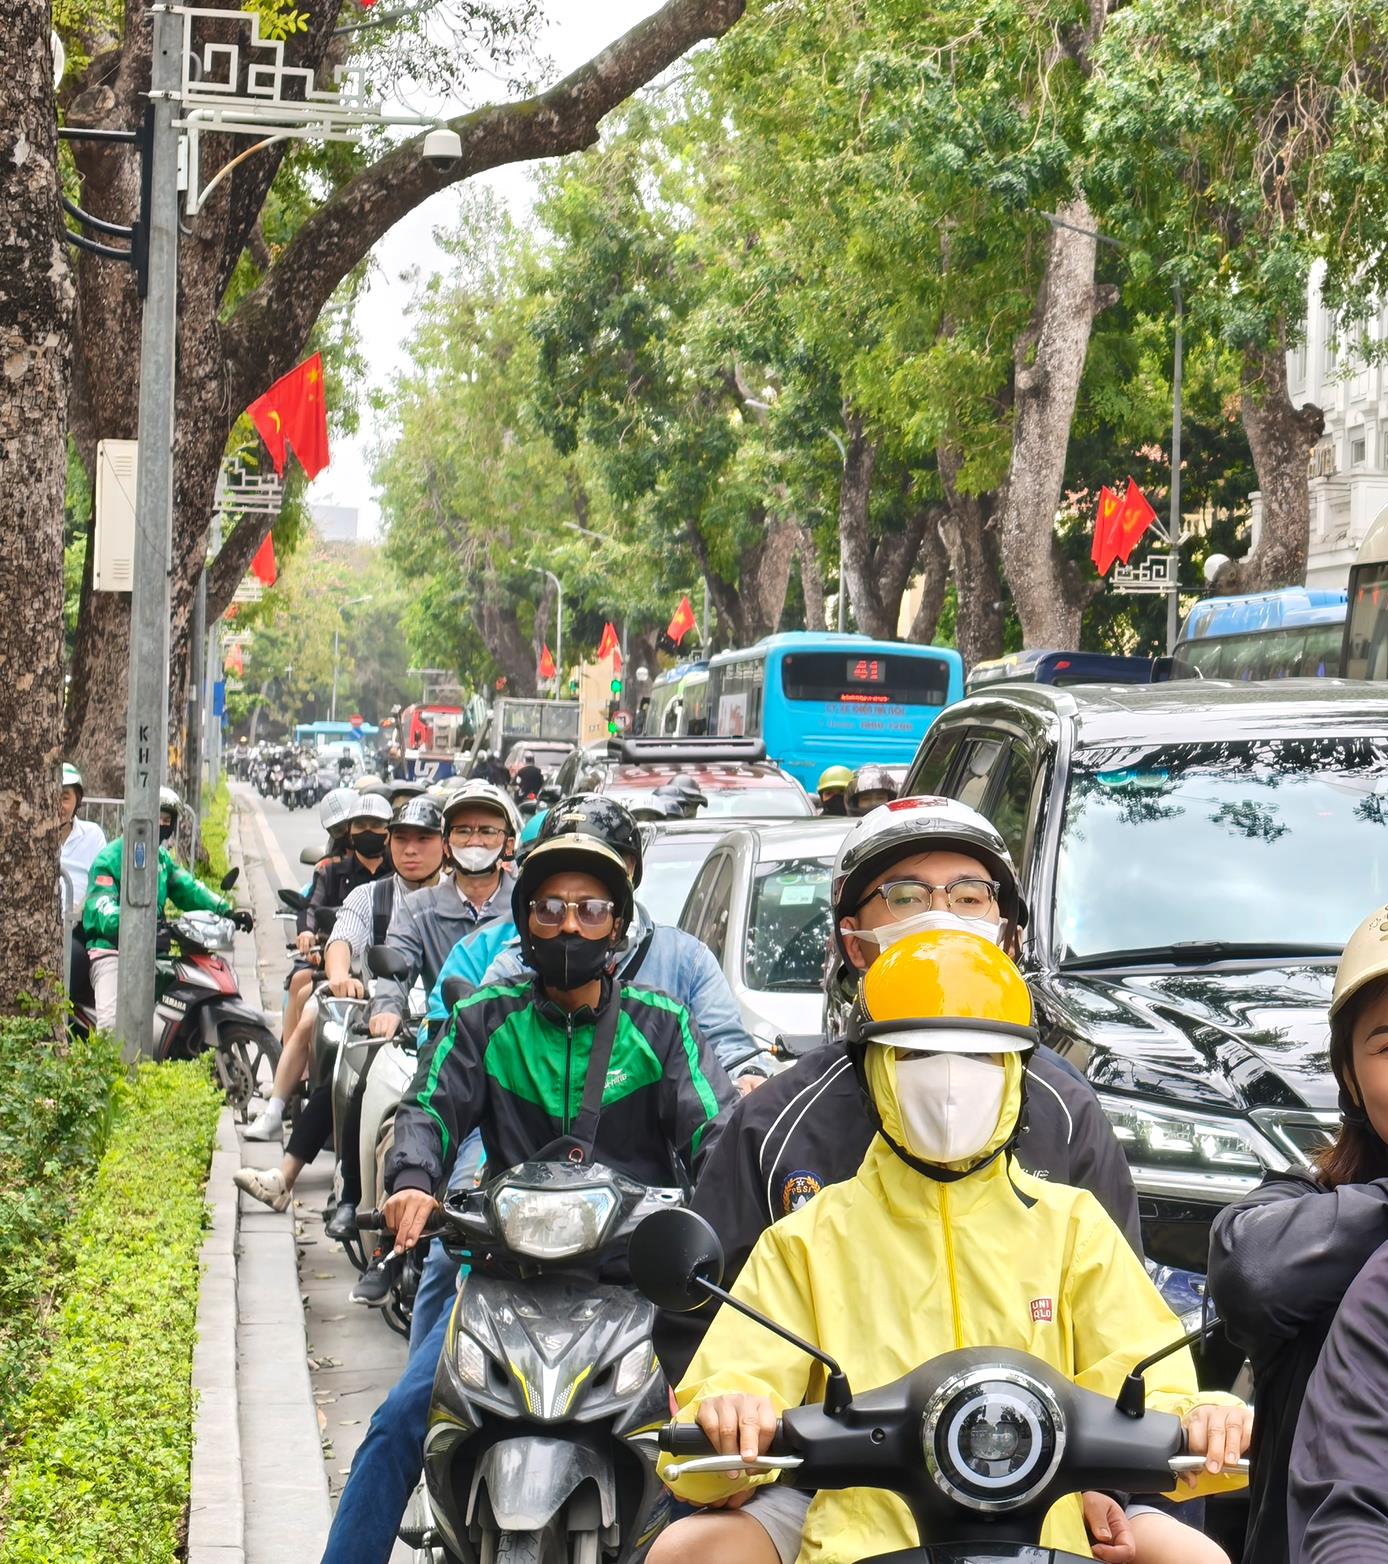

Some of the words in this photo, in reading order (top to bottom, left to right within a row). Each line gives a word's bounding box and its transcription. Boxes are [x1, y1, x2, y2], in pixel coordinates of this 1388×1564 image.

[853, 660, 879, 680] 41
[162, 994, 187, 1012] YAMAHA
[1032, 1299, 1050, 1310] UNI
[1033, 1309, 1051, 1319] QLO
